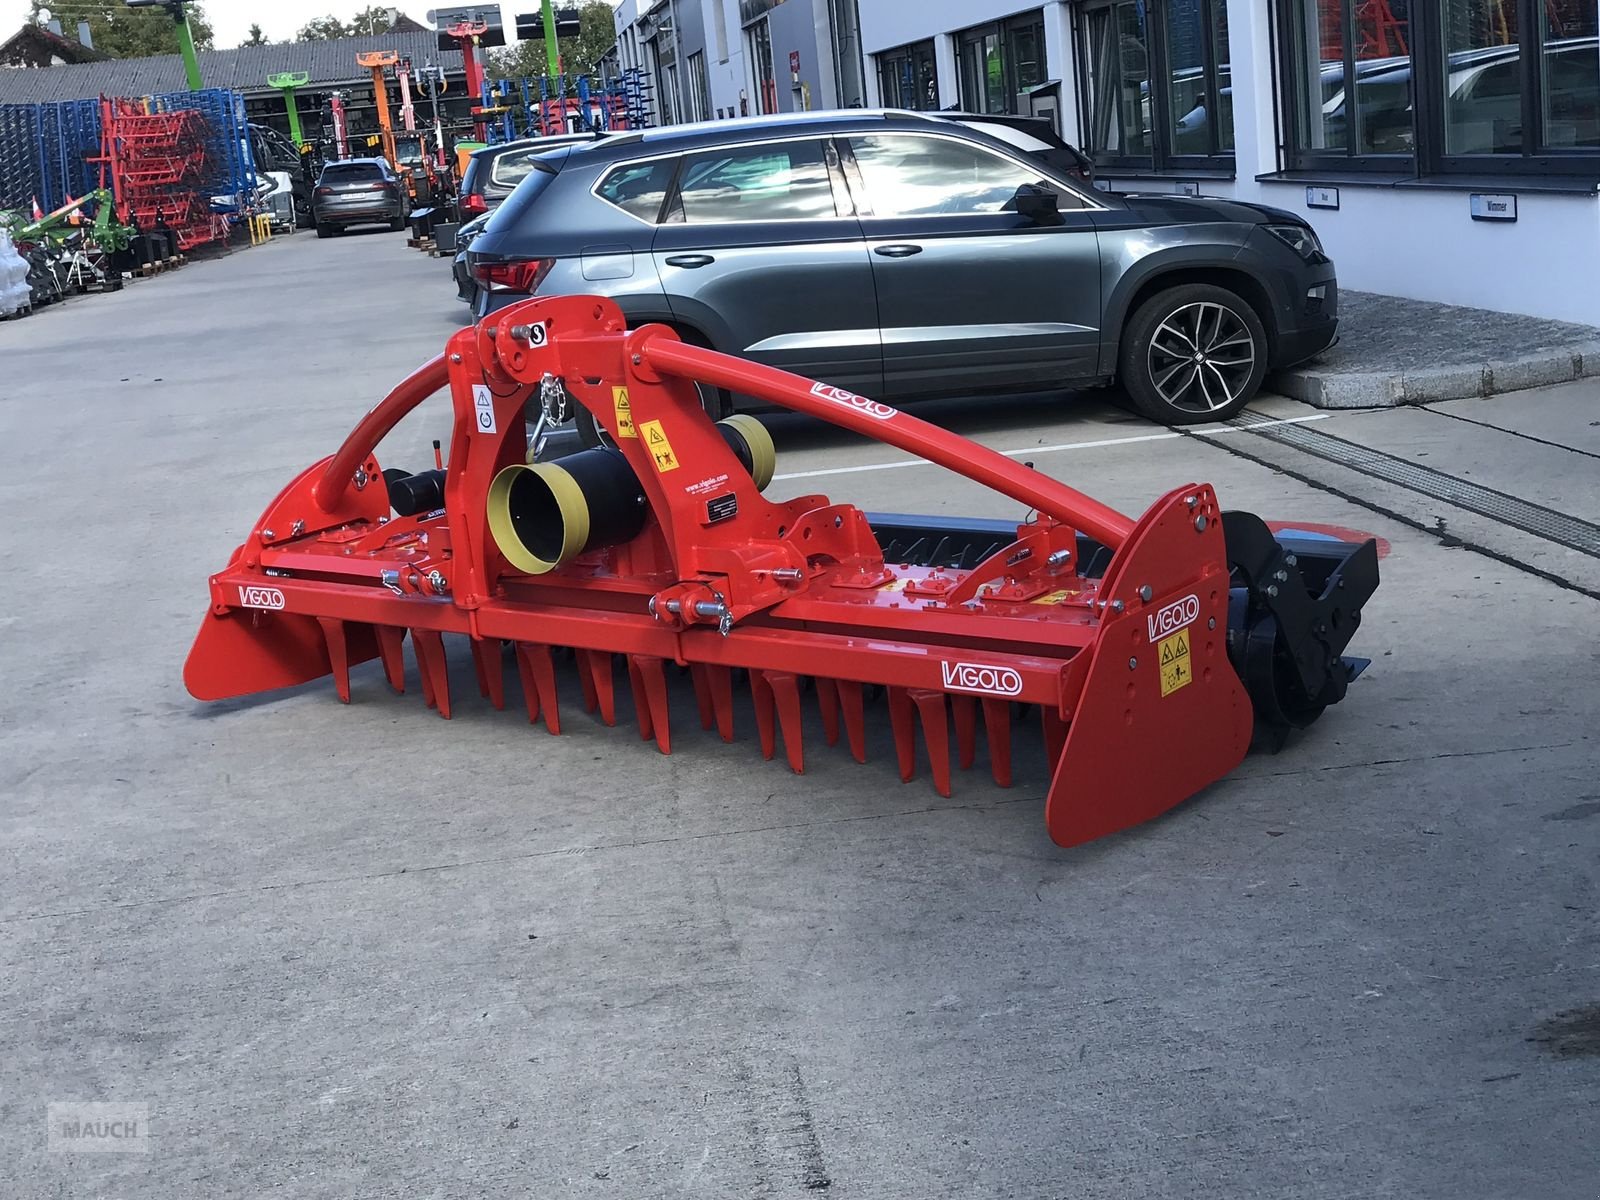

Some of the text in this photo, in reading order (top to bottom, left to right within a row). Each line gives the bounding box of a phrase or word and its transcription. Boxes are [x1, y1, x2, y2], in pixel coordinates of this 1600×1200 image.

[810, 381, 898, 420] VIGOLO
[238, 585, 285, 610] VIGOLO
[1147, 594, 1200, 643] VIGOLO
[941, 660, 1023, 696] VIGOLO
